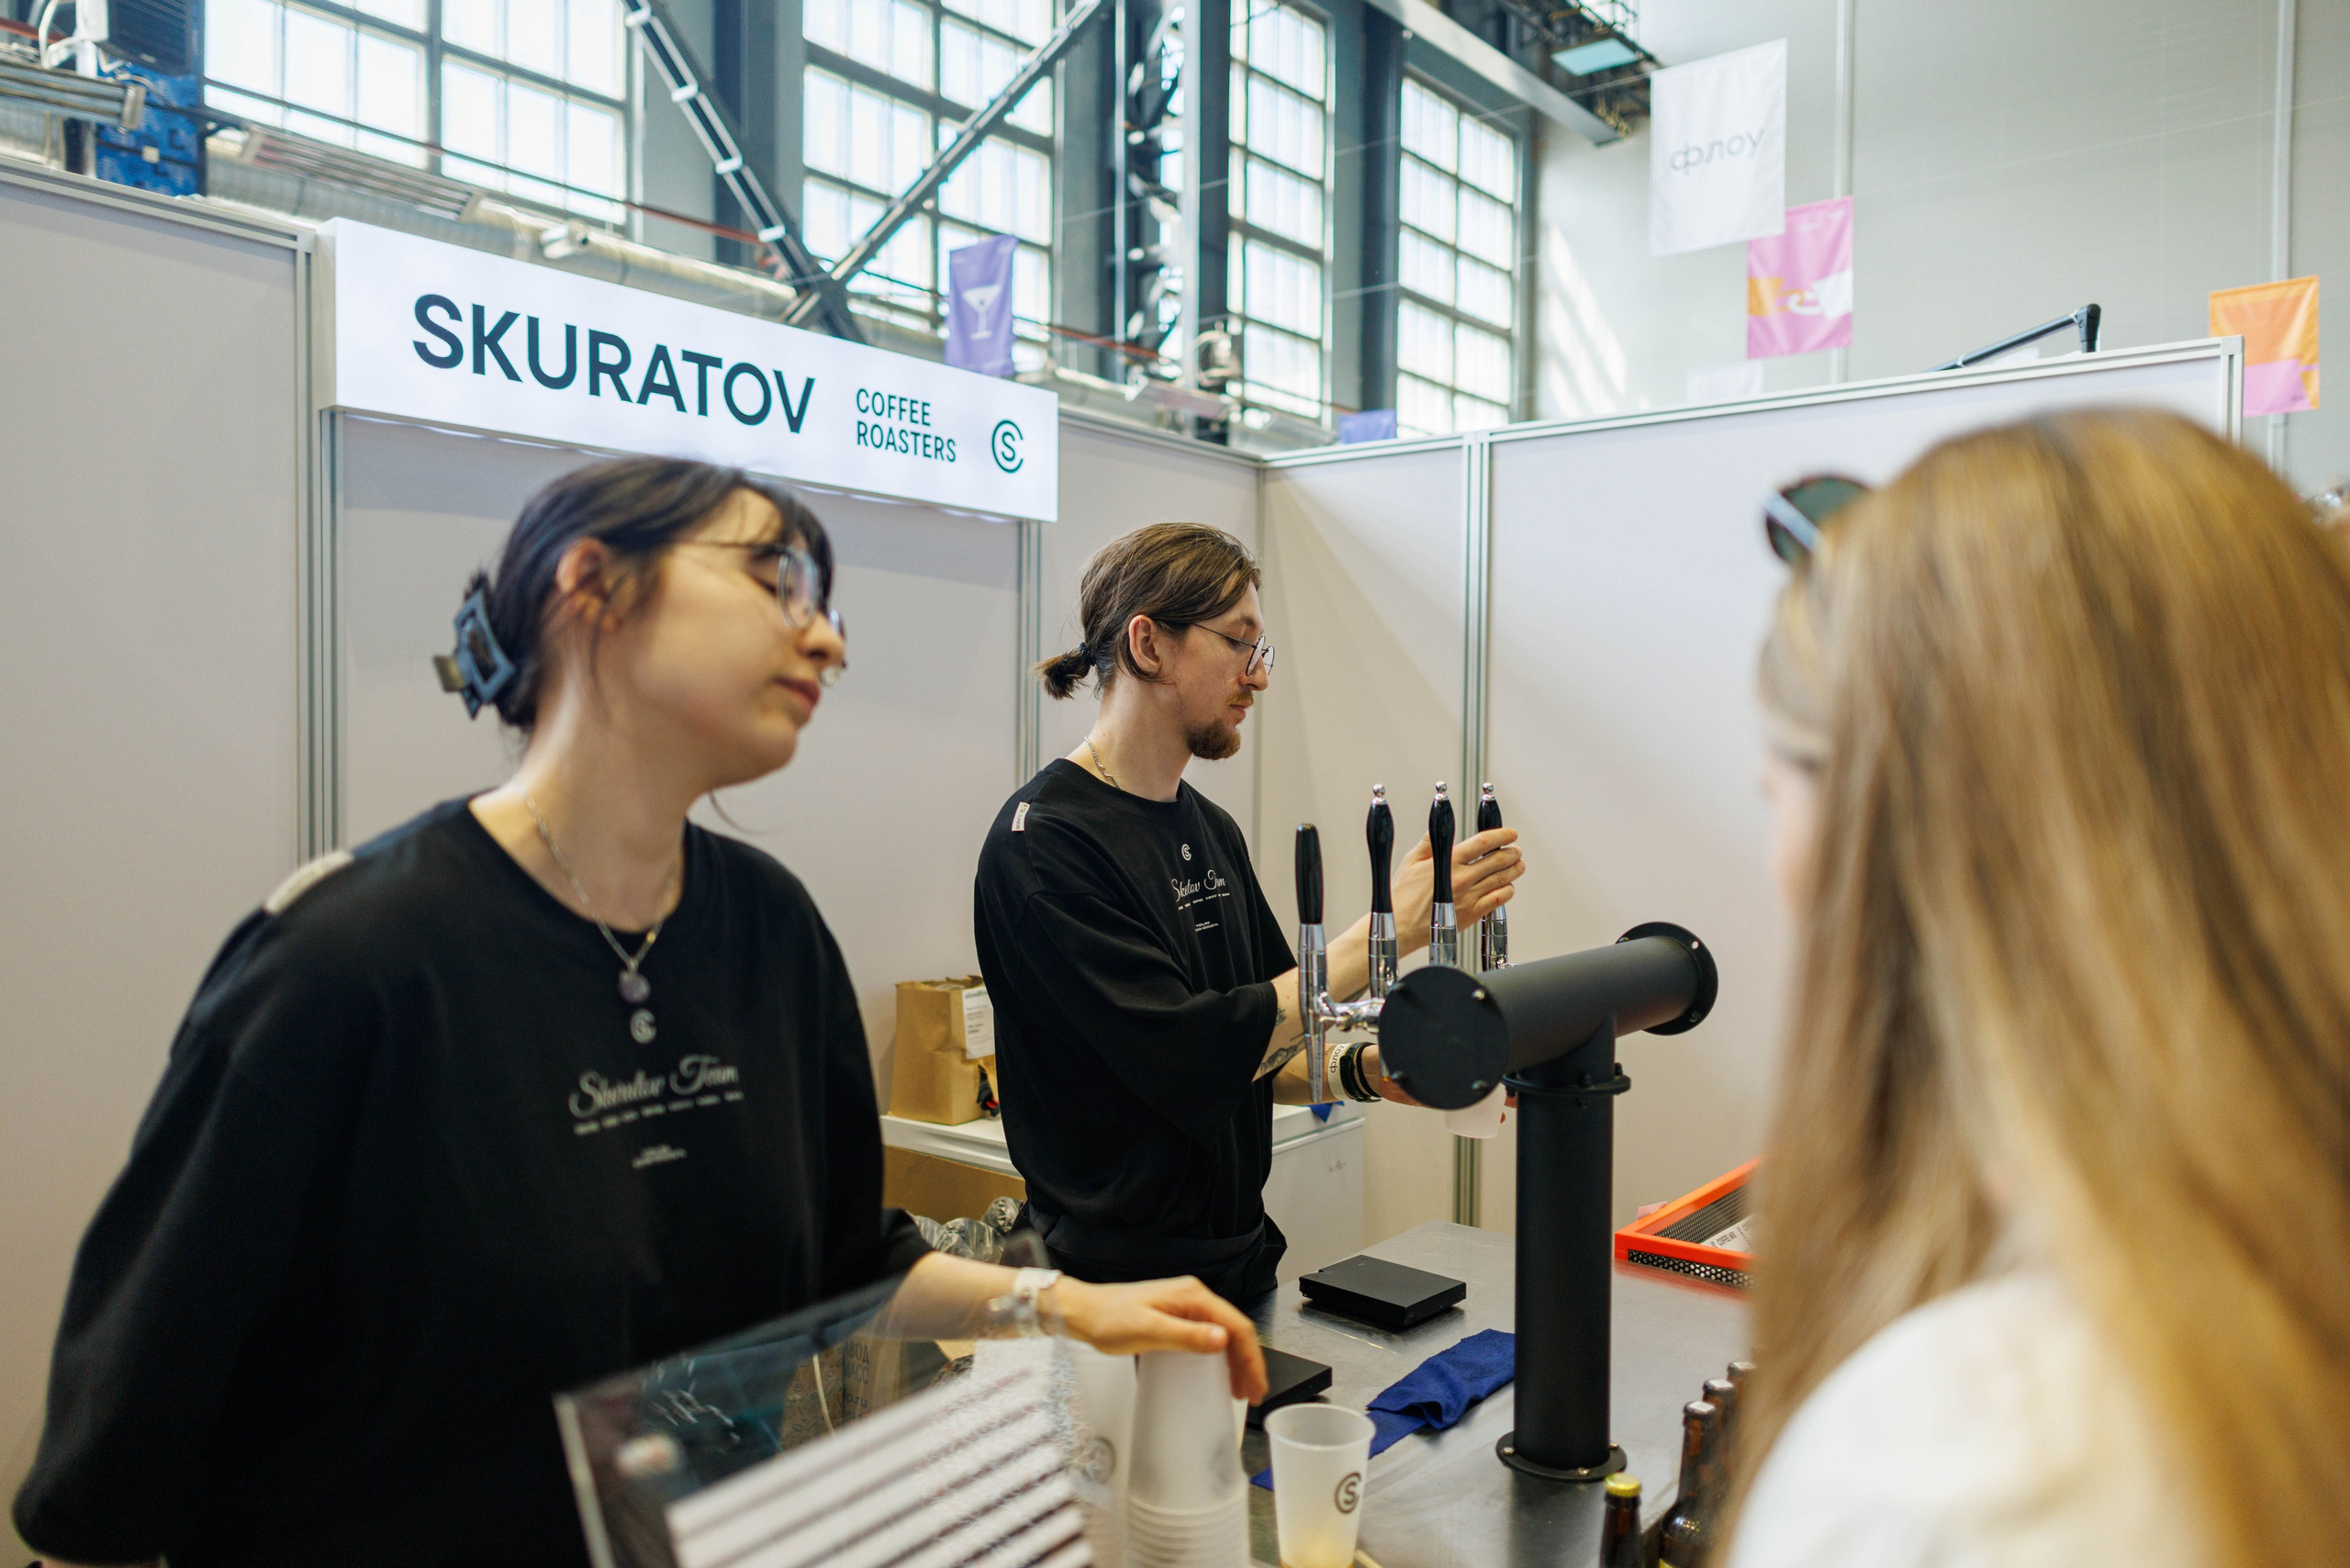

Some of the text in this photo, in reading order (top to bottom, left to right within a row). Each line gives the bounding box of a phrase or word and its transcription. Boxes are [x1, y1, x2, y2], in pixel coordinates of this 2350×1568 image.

[1670, 128, 1764, 176] флоу
[412, 293, 815, 433] SKURATOV
[856, 387, 931, 426] COFFEE
[856, 419, 957, 463] ROASTERS
